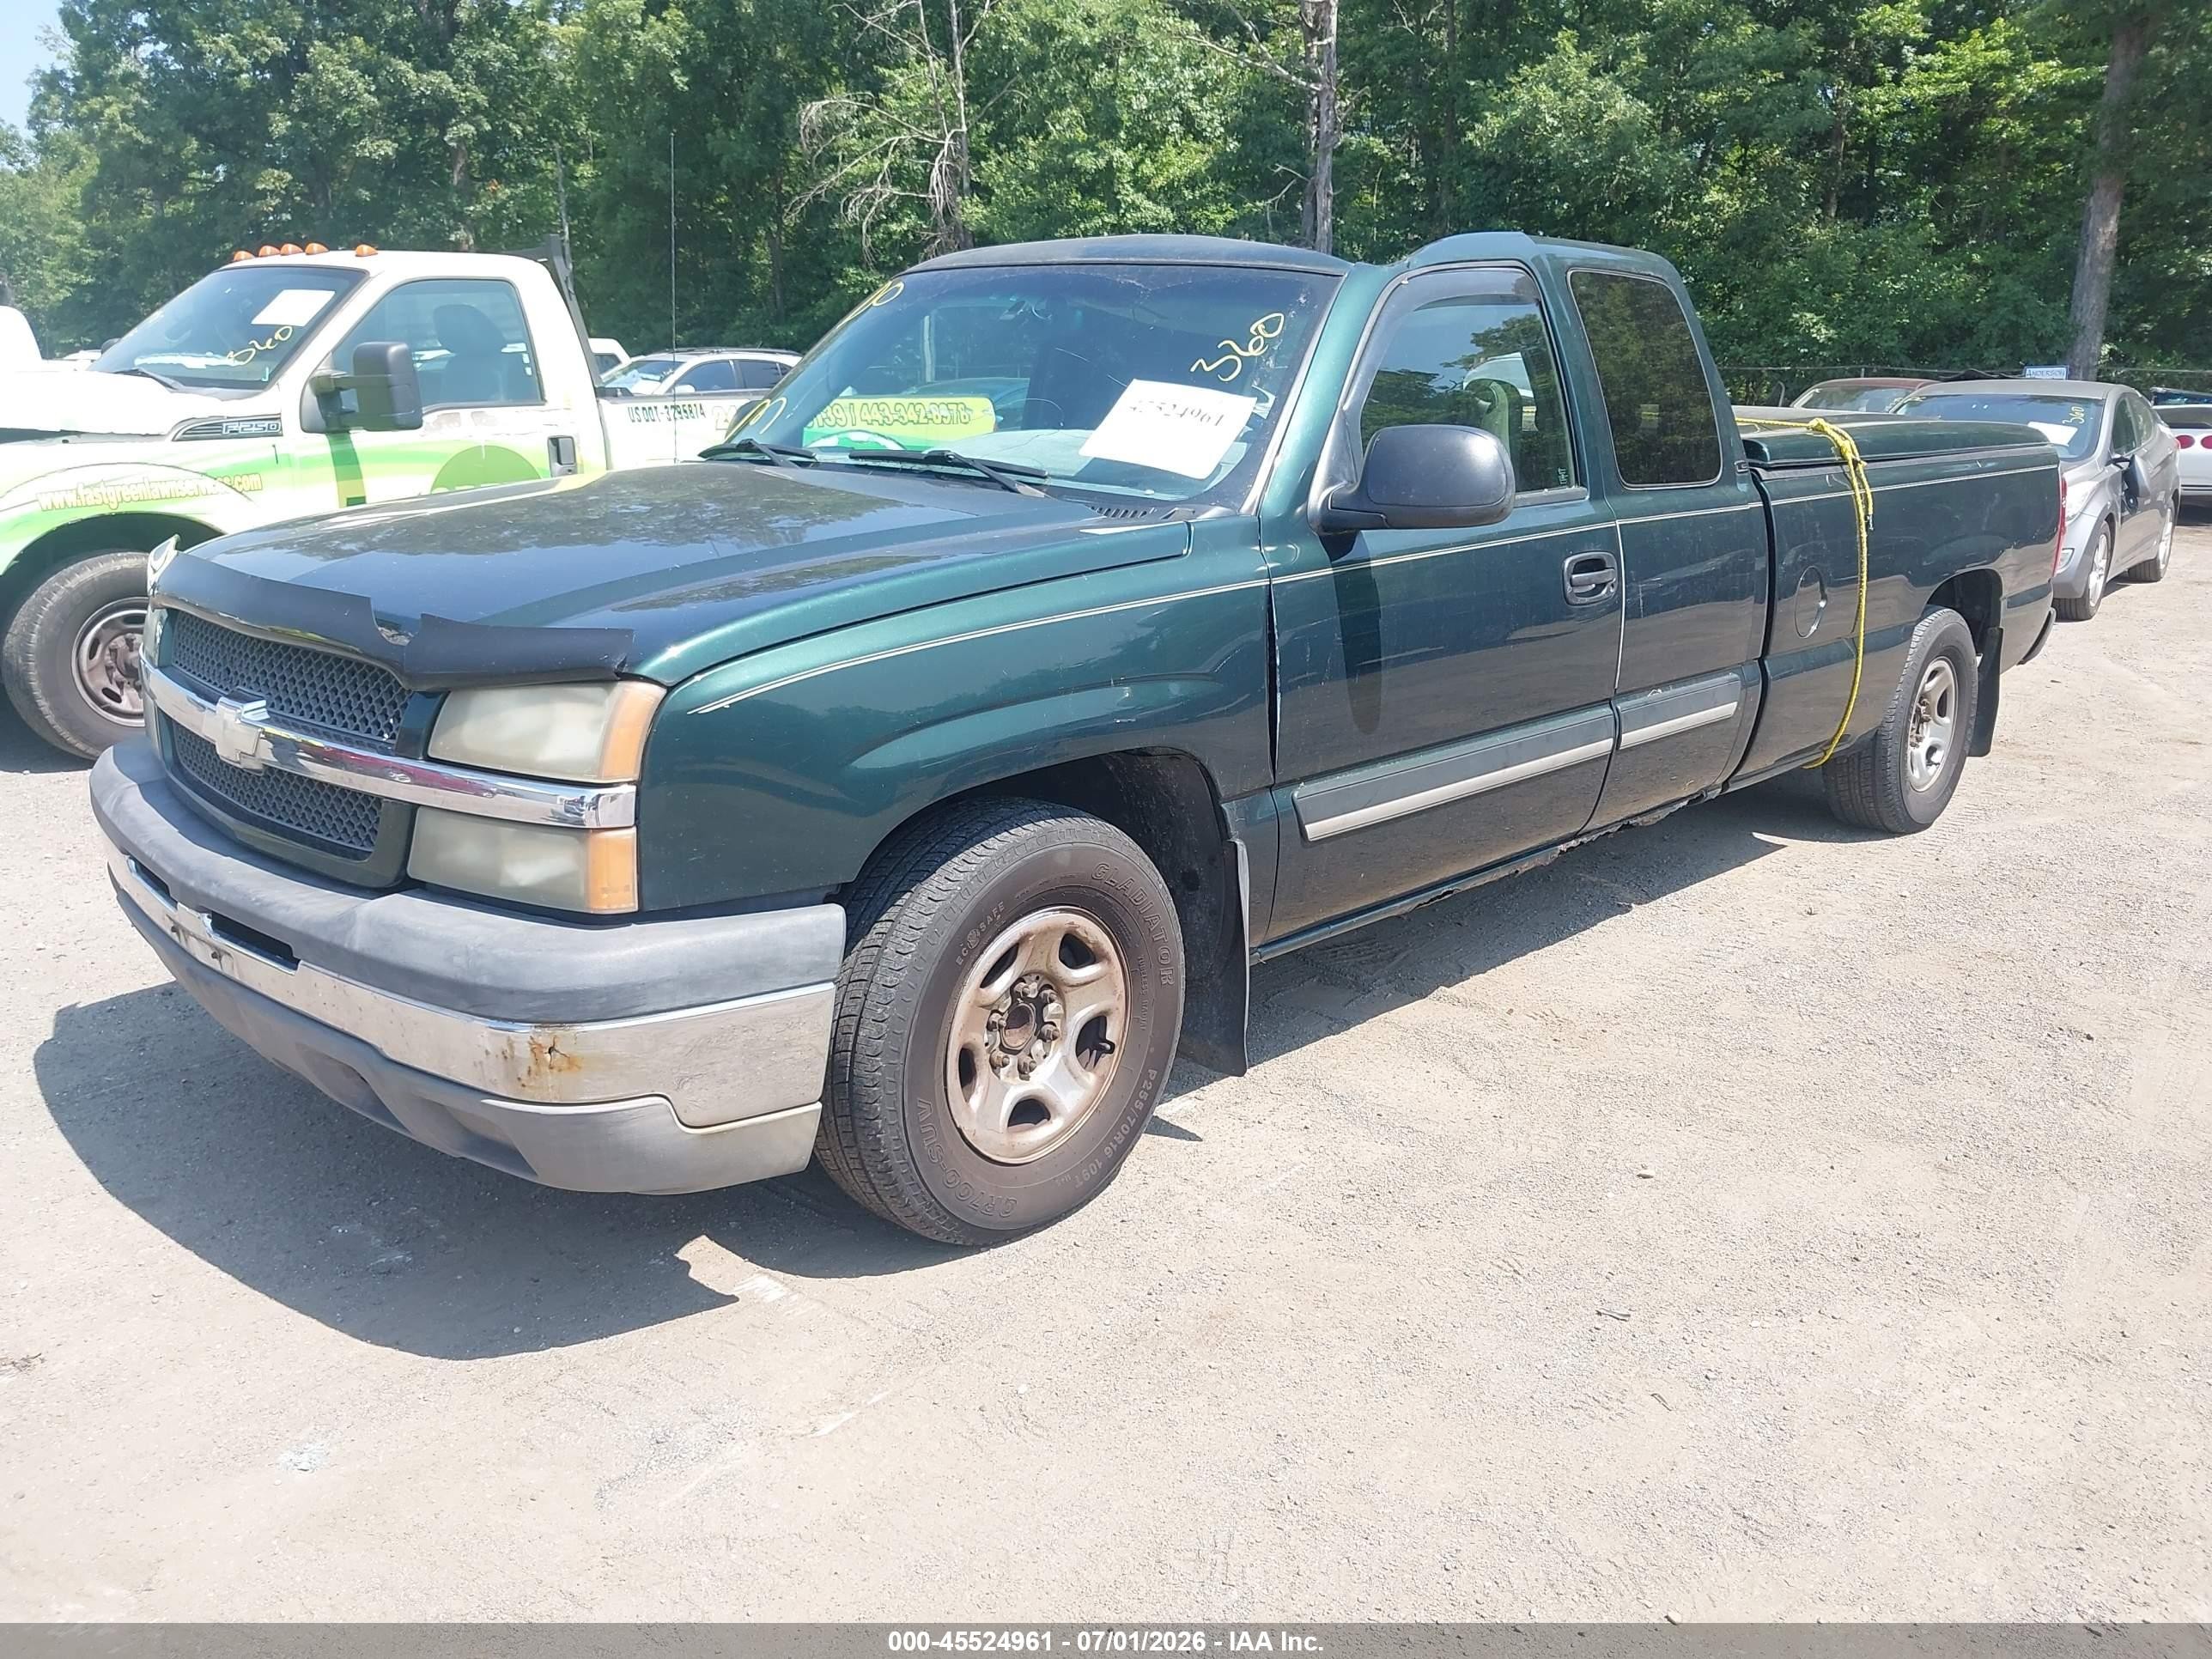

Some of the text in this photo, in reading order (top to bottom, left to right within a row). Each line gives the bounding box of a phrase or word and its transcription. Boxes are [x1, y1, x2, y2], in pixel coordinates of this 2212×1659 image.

[1189, 313, 1285, 382] 360
[2062, 406, 2085, 424] 360
[36, 472, 263, 511] www.fastgreenlawnserves.com
[1091, 862, 1176, 986] GLADIATOR
[1103, 1068, 1158, 1158] P255/70R16
